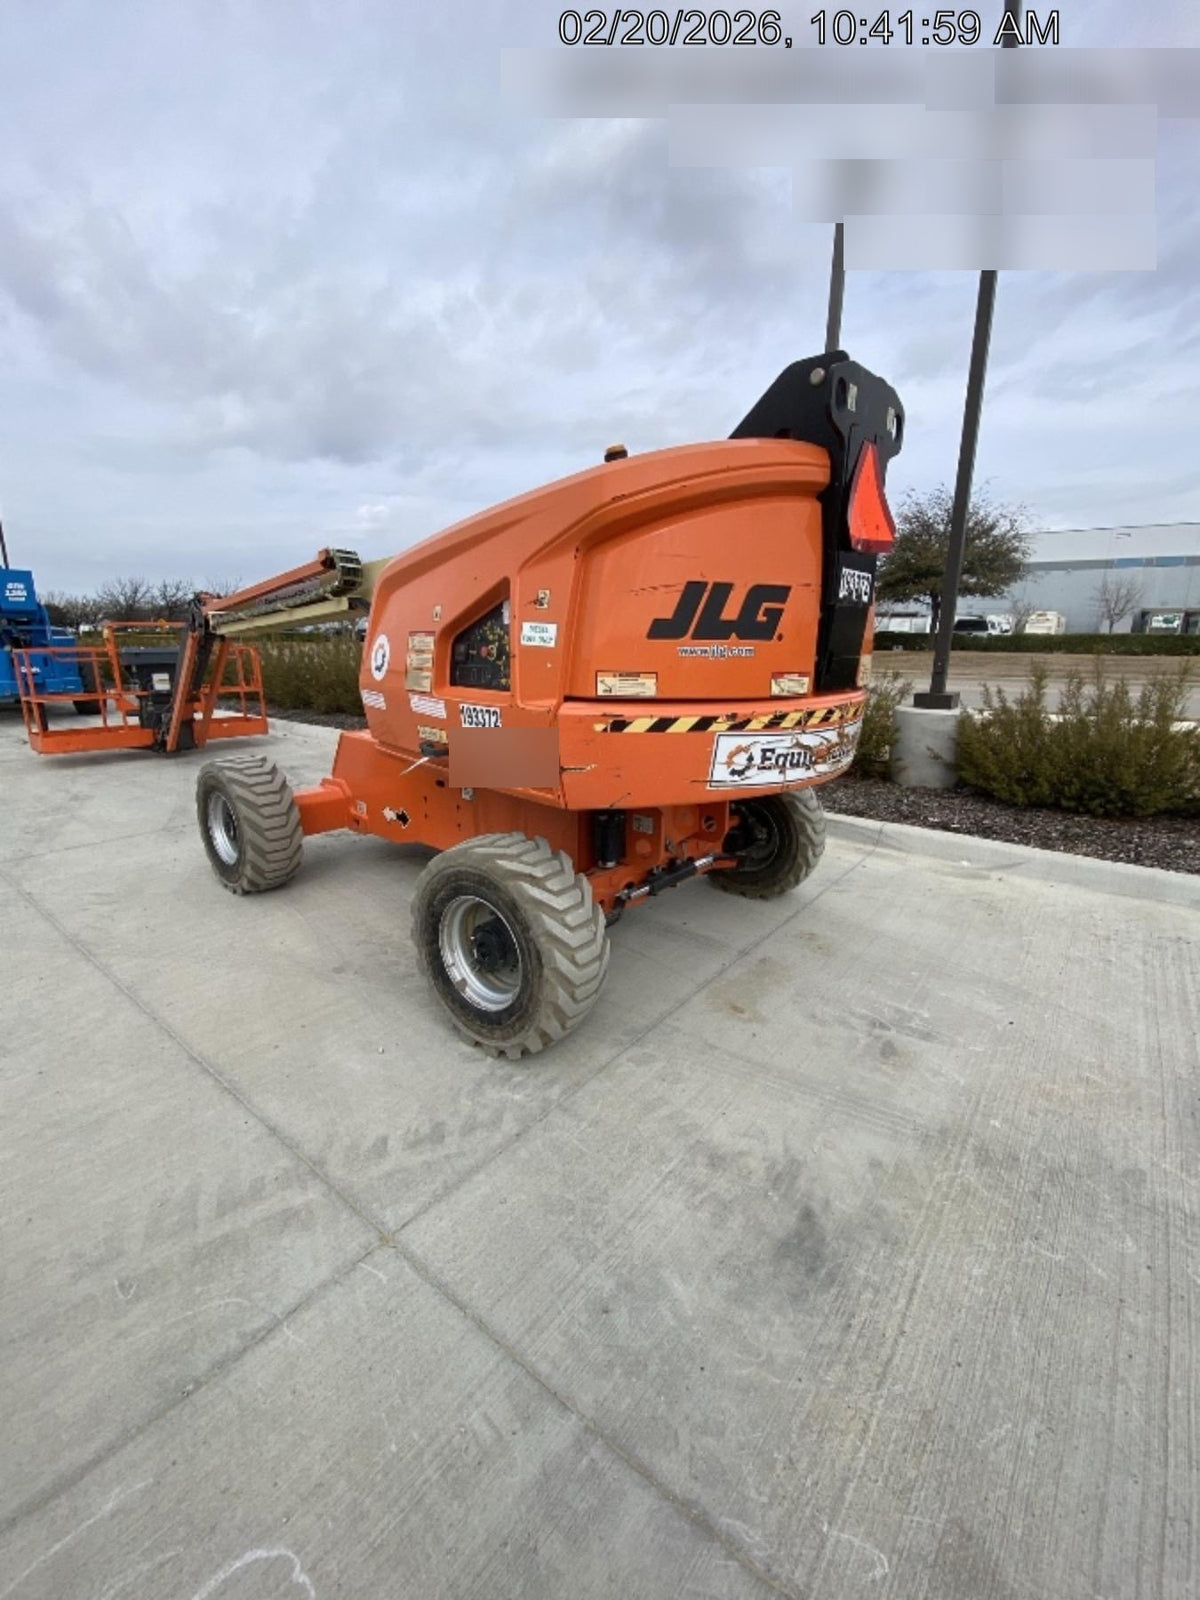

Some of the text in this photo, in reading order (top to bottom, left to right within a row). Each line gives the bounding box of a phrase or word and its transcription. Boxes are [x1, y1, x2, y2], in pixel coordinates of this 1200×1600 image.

[646, 581, 792, 641] JLG
[677, 646, 755, 660] www.jlg.com
[461, 705, 500, 727] 193372
